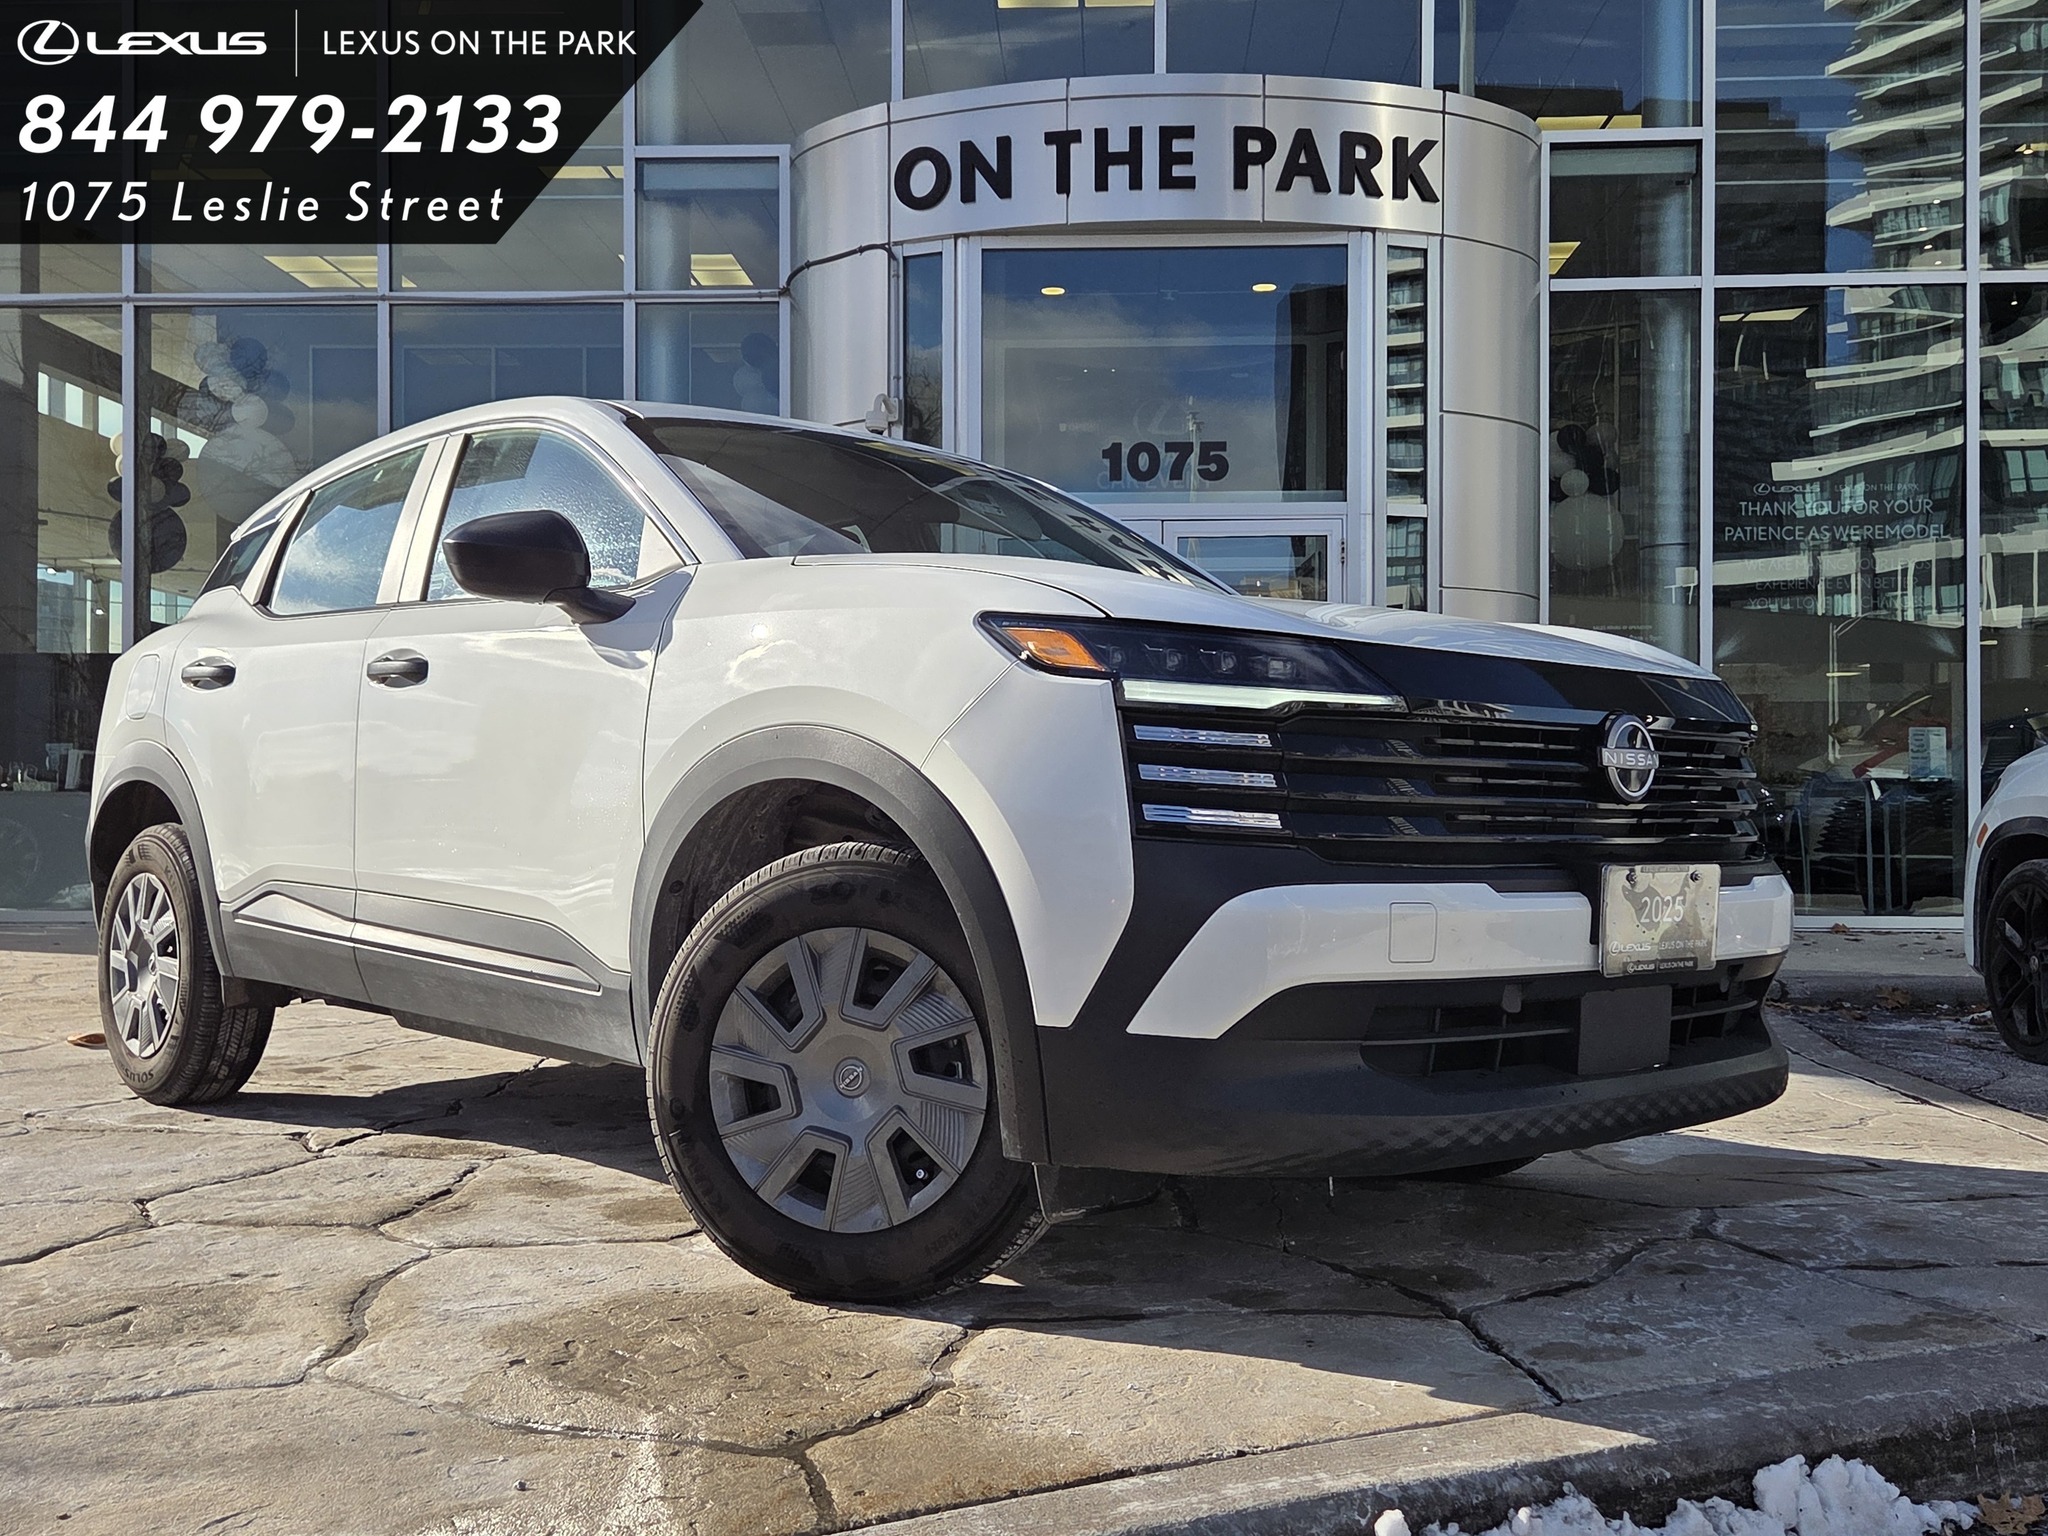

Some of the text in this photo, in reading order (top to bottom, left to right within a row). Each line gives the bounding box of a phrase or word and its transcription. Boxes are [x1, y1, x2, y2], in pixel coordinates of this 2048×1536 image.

[894, 125, 1440, 211] ON THE PARK
[1101, 440, 1230, 482] 1075
[1739, 501, 1798, 516] THANK
[1804, 499, 1841, 515] YOU
[1883, 498, 1934, 515] YOUR
[1724, 523, 1950, 541] PATIENCE AS WE REMODEL
[1755, 577, 1833, 590] EXPERIENE
[1836, 576, 1871, 590] EVN
[1603, 750, 1659, 767] NISSAN
[1640, 896, 1684, 923] 2025
[1620, 942, 1652, 953] LEXUS
